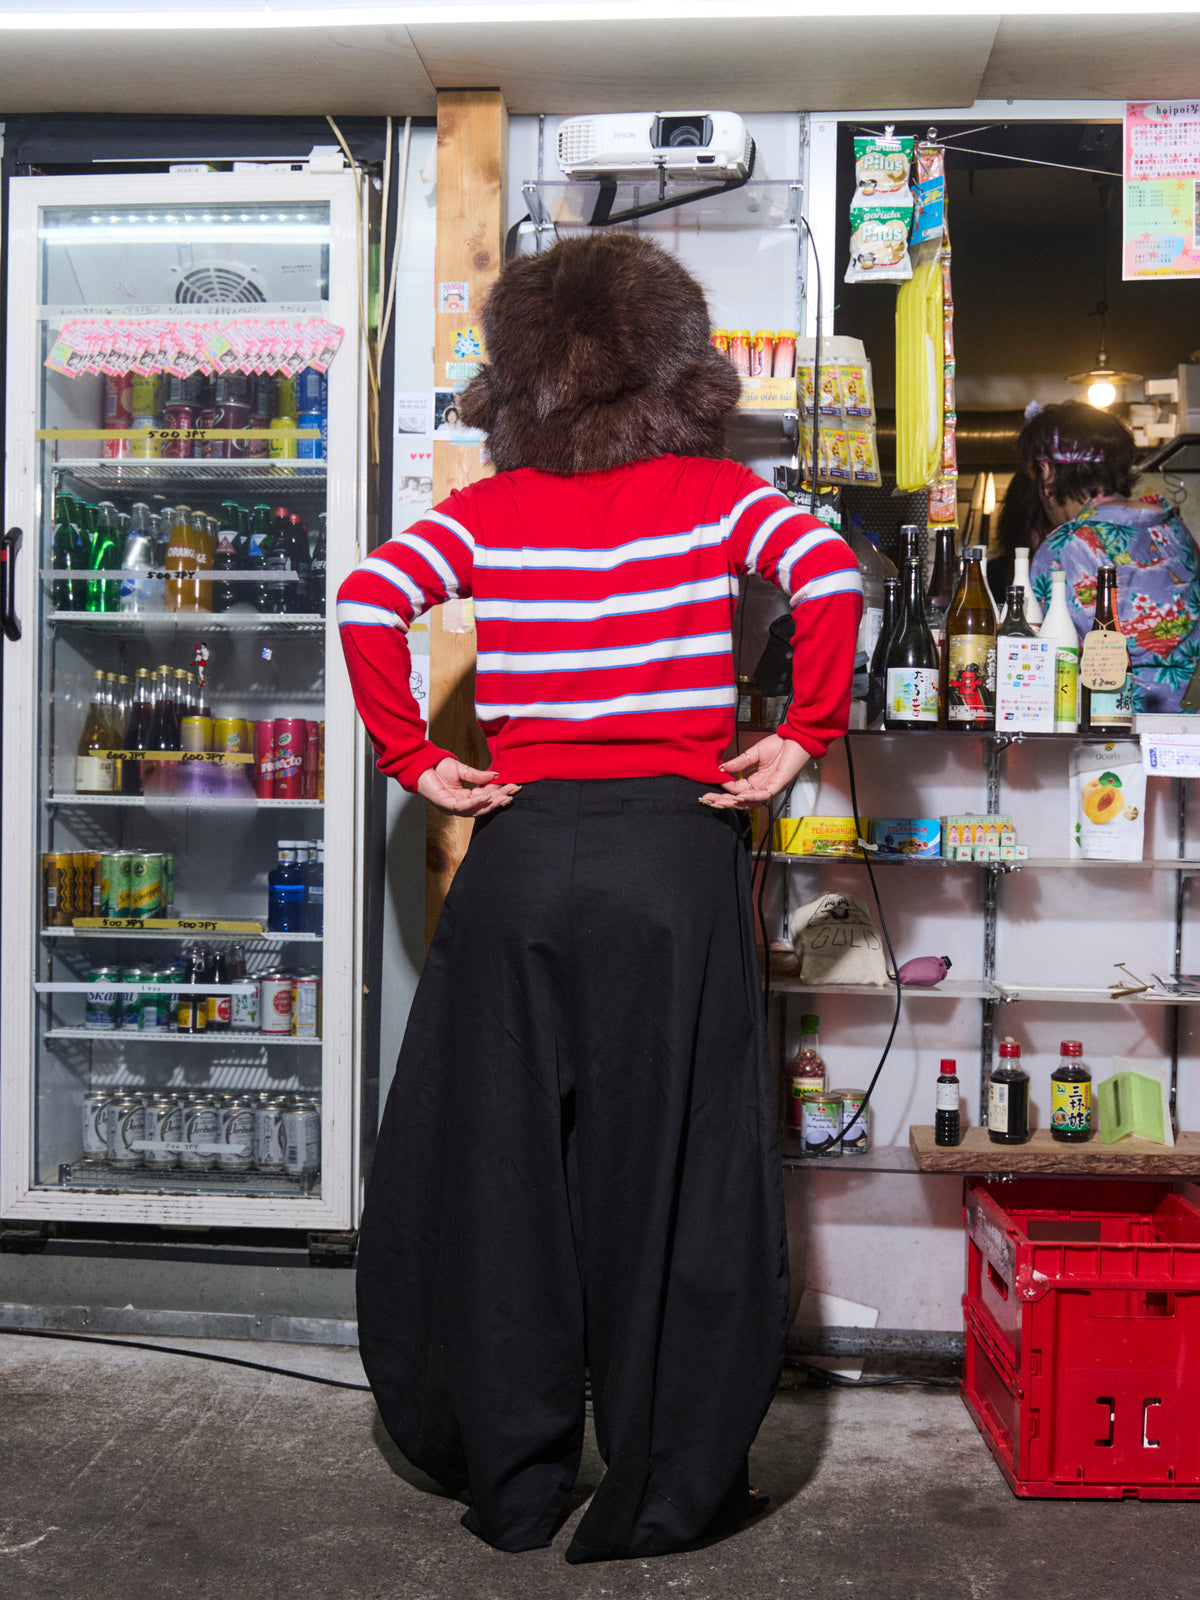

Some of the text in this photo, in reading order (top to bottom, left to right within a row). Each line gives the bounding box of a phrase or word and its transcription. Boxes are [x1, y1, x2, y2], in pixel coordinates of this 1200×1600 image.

[612, 131, 636, 140] EPSON
[863, 154, 904, 171] Pilus
[863, 209, 901, 220] garuda
[148, 430, 207, 439] 500 JPY
[147, 571, 196, 580] 500 JPY
[106, 751, 147, 760] 600 JPY
[181, 752, 226, 762] 600 JPY
[103, 919, 144, 928] 500 JPY
[177, 920, 218, 930] 500 JPY
[1068, 1085, 1086, 1129] 三杯酢
